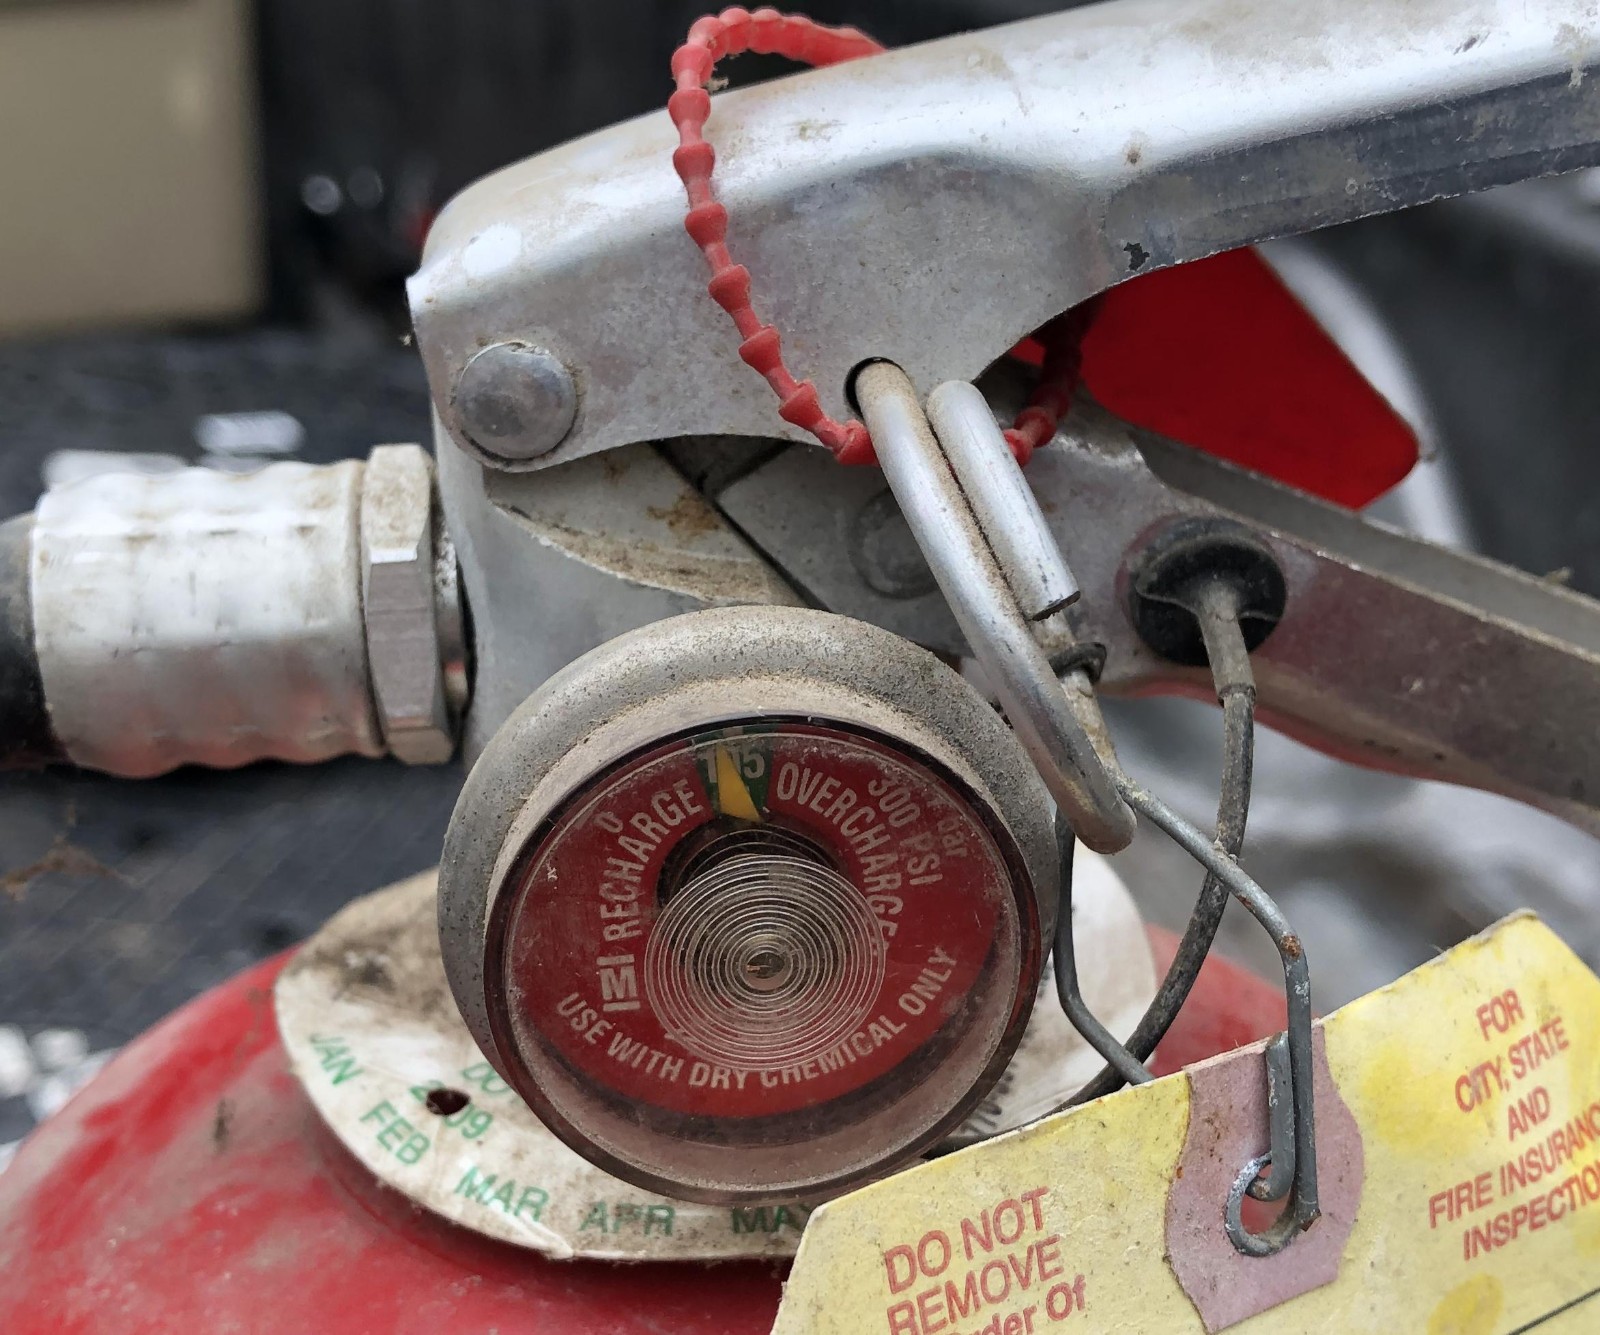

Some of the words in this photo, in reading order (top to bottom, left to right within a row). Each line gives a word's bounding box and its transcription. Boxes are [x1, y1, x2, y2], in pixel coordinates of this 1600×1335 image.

[700, 744, 766, 784] 15
[599, 777, 704, 942] RECHARGE
[867, 774, 921, 828] 300
[899, 831, 944, 887] PSI
[556, 992, 613, 1045] USE
[607, 1031, 684, 1083] WITH
[688, 1062, 750, 1090] DRY
[759, 1015, 907, 1088] CHEMICAL
[898, 945, 958, 1017] ONLY
[1476, 989, 1524, 1041] FOR
[309, 1034, 365, 1086] JAN
[1508, 1016, 1569, 1080] STATE
[359, 1099, 431, 1166] FEB
[409, 1080, 494, 1140] 209
[1508, 1086, 1551, 1142] AND
[454, 1166, 550, 1222] MAR
[578, 1200, 677, 1236] APR
[731, 1204, 812, 1235] MA
[1428, 1171, 1494, 1229] FIRE
[885, 1229, 951, 1294] DO
[961, 1186, 1050, 1260] NOT
[887, 1234, 1064, 1335] REMOVE
[949, 1305, 1038, 1335] der
[1046, 1274, 1086, 1321] Of
